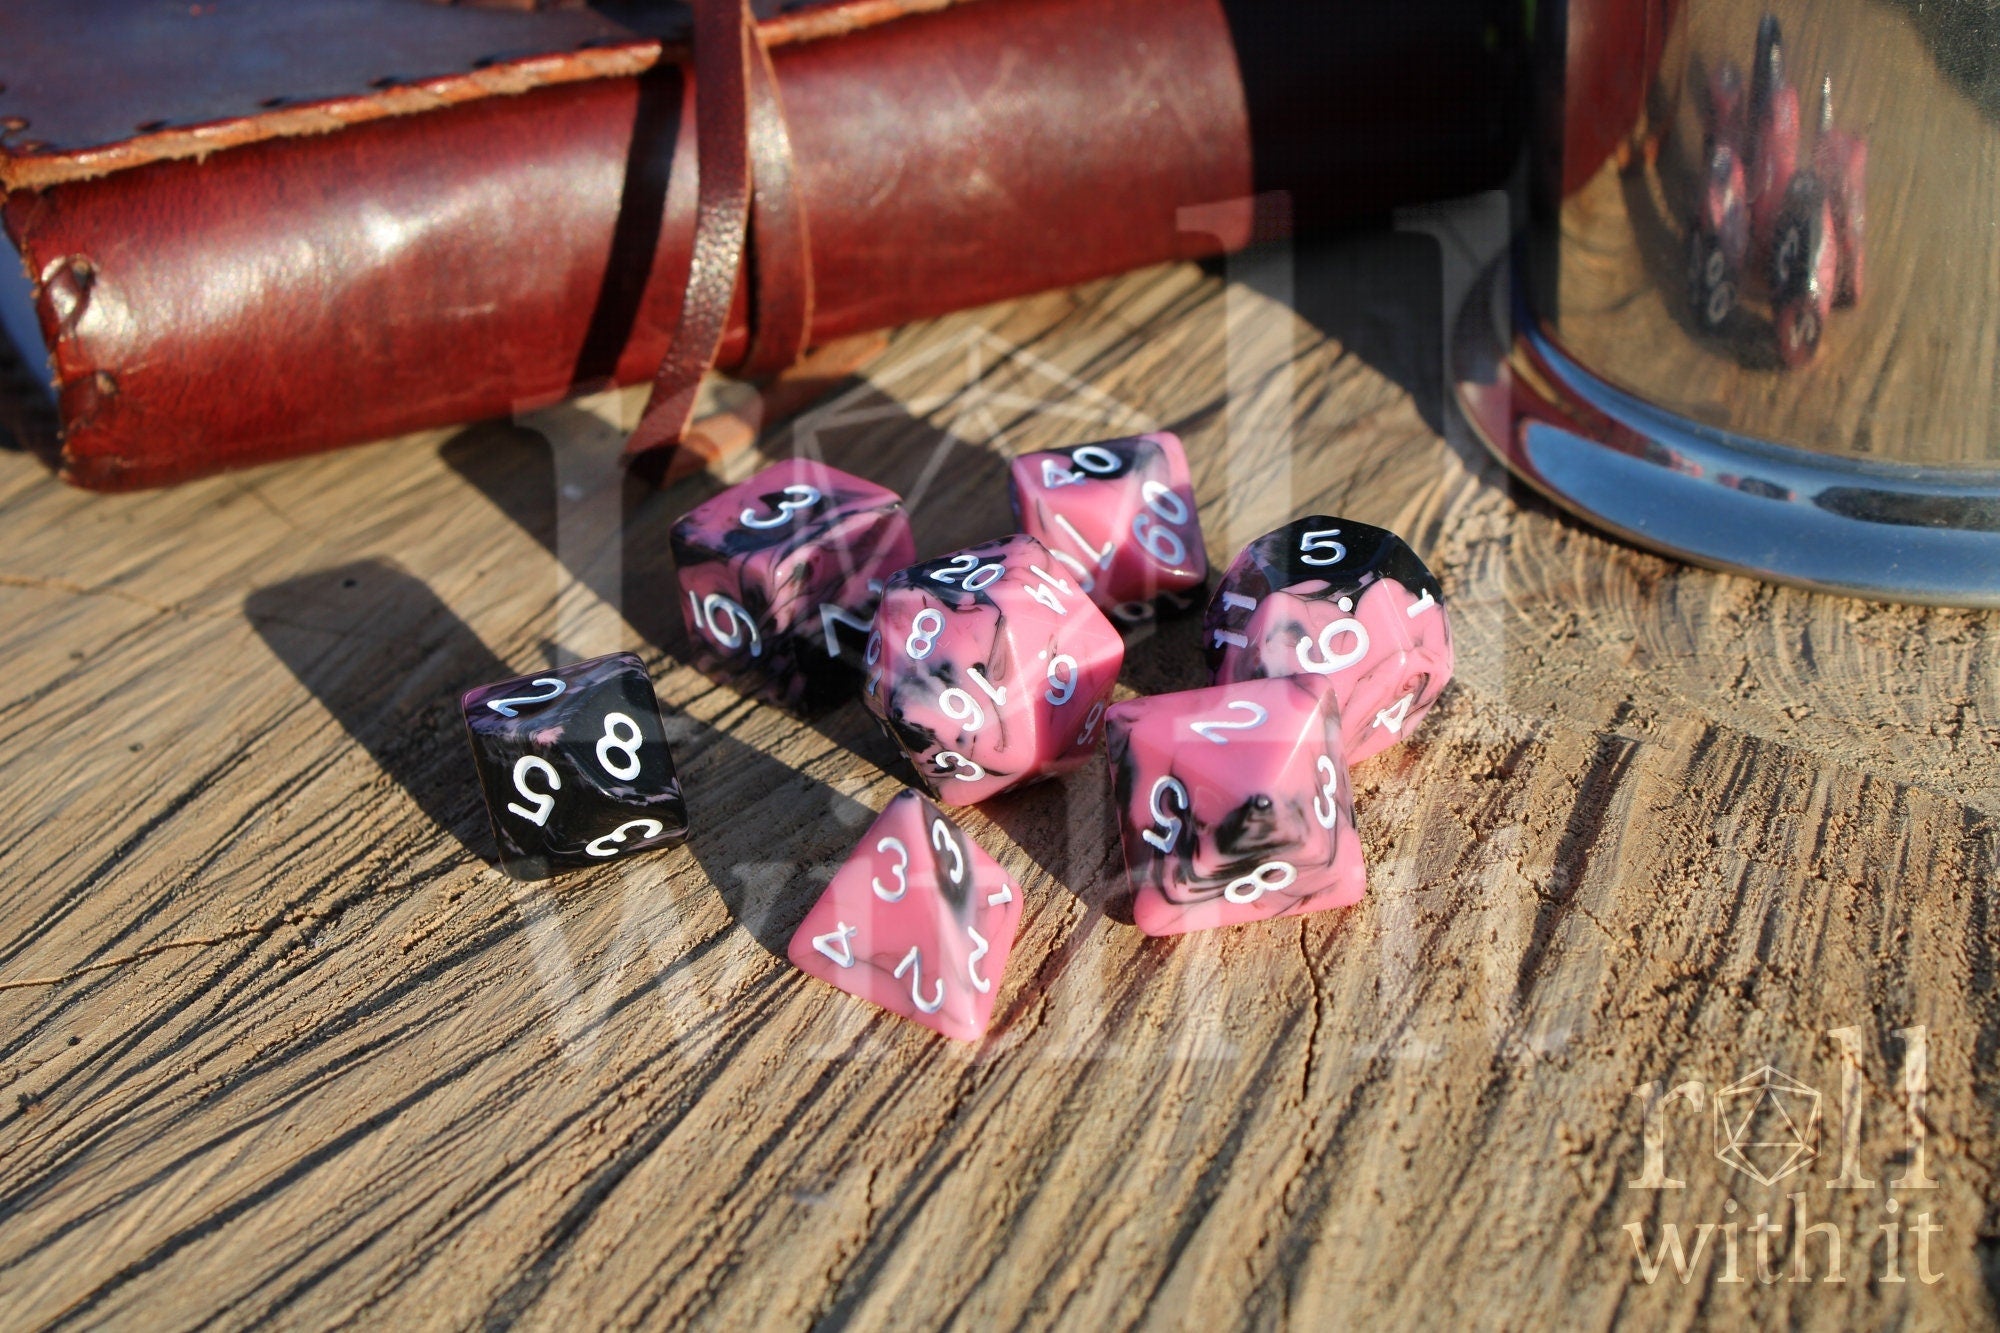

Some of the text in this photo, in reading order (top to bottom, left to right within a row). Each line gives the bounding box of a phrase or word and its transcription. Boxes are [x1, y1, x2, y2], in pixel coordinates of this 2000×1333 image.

[1042, 446, 1123, 488] 40
[740, 485, 821, 529] 3
[1300, 529, 1347, 566] 5
[930, 554, 1006, 591] 20
[1024, 564, 1073, 616] 14
[1213, 590, 1257, 649] 11
[1406, 587, 1435, 619] 1
[905, 608, 945, 660] 8
[486, 678, 567, 718] 2
[1373, 693, 1415, 734] 4
[1190, 701, 1268, 745] 2
[595, 711, 643, 781] 8
[935, 751, 986, 781] 3
[507, 755, 562, 827] 5
[1313, 754, 1338, 829] 3
[1142, 774, 1188, 855] 5
[585, 818, 664, 858] 3
[932, 818, 964, 884] 3
[872, 836, 909, 902] 3
[1224, 860, 1298, 904] 8
[987, 882, 1013, 907] 1
[812, 921, 858, 968] 4
[968, 925, 991, 994] 2
[893, 945, 946, 1014] 2
